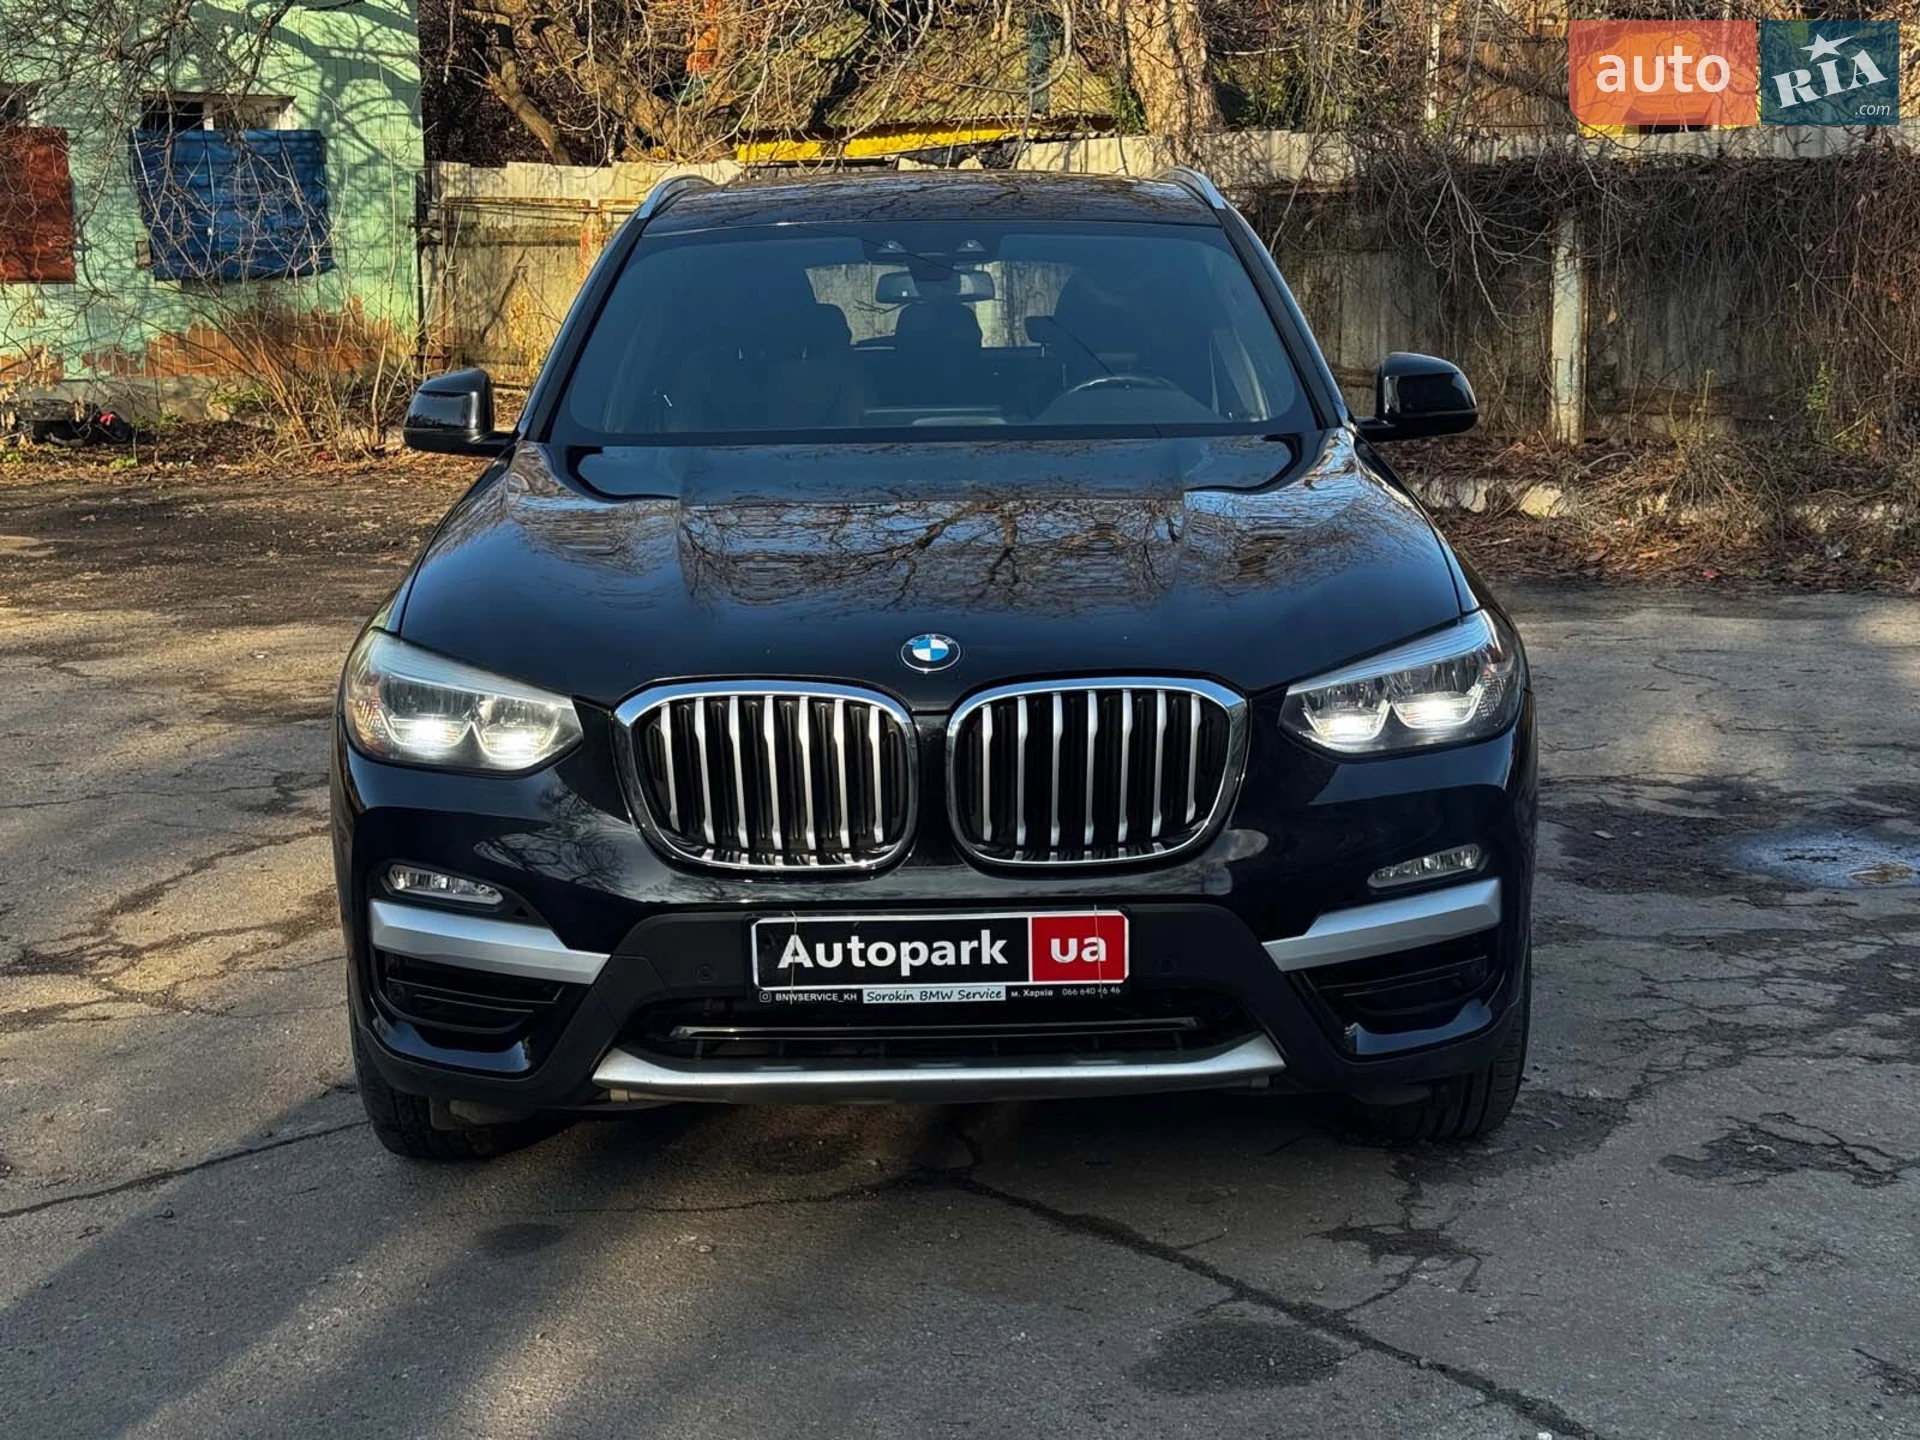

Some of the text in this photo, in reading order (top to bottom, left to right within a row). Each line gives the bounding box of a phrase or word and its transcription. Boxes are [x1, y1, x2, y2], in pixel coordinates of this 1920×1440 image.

[777, 929, 1107, 977] Autopark ua
[866, 988, 1002, 1002] Sorokin BMW Service
[1061, 988, 1078, 996] 066
[1110, 985, 1121, 994] 46
